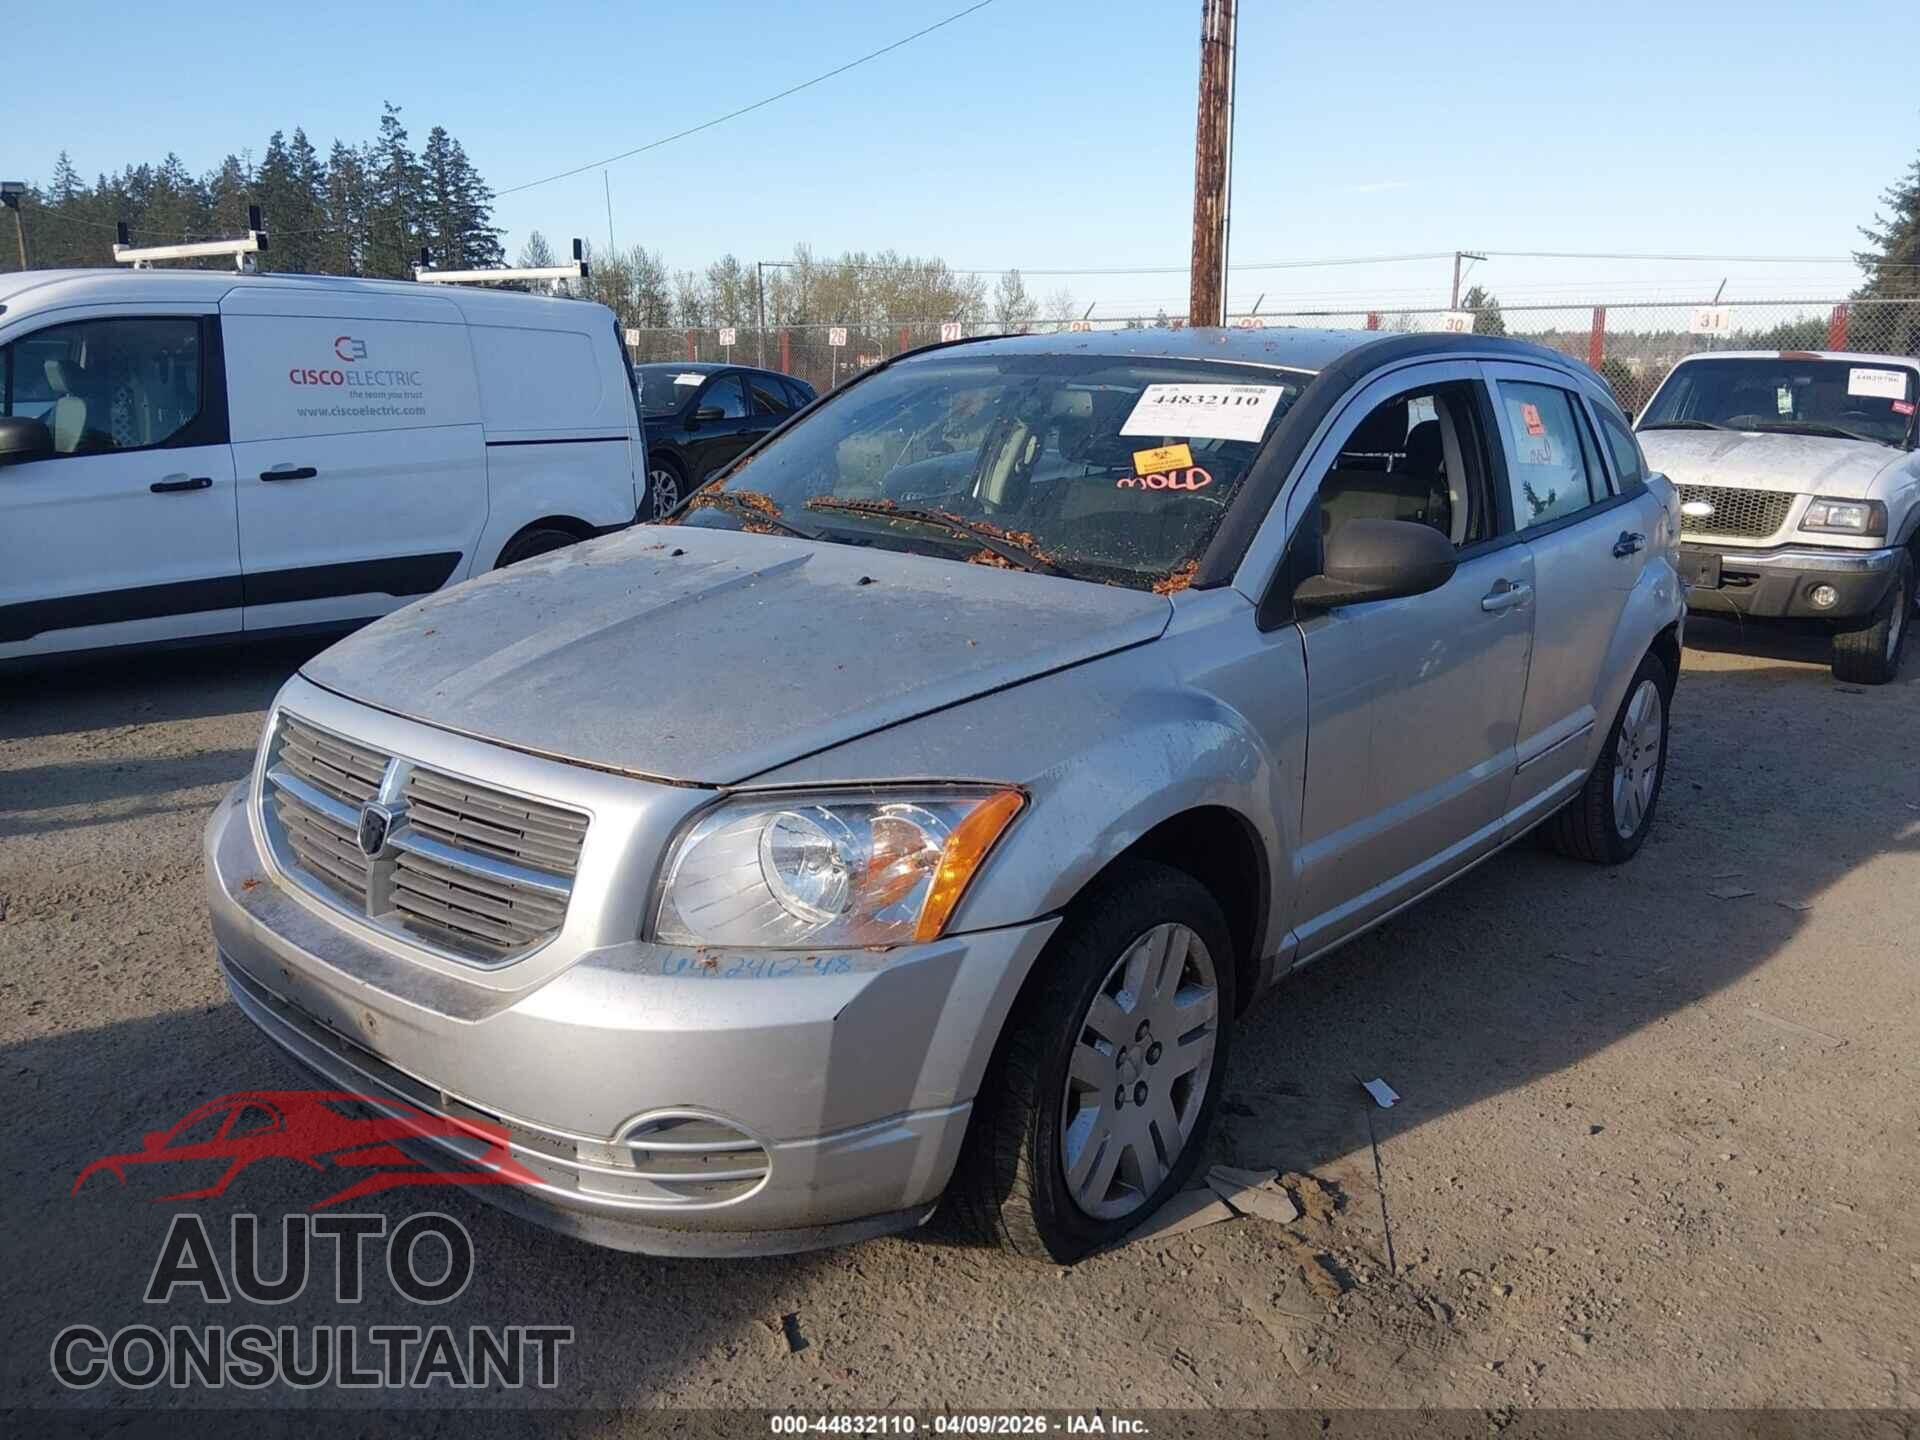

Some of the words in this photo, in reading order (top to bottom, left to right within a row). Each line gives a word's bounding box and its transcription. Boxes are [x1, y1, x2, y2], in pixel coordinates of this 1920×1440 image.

[1700, 313, 1720, 328] 31
[721, 330, 735, 343] 25
[830, 329, 844, 343] 26
[944, 325, 958, 339] 27
[289, 368, 345, 386] CISCO
[346, 370, 423, 386] ELECTRIC
[350, 390, 363, 399] the
[365, 391, 386, 399] team
[387, 391, 403, 400] you
[404, 391, 423, 399] trust
[1152, 394, 1260, 407] 44832110
[297, 405, 426, 417] www.ciscoelectric.com
